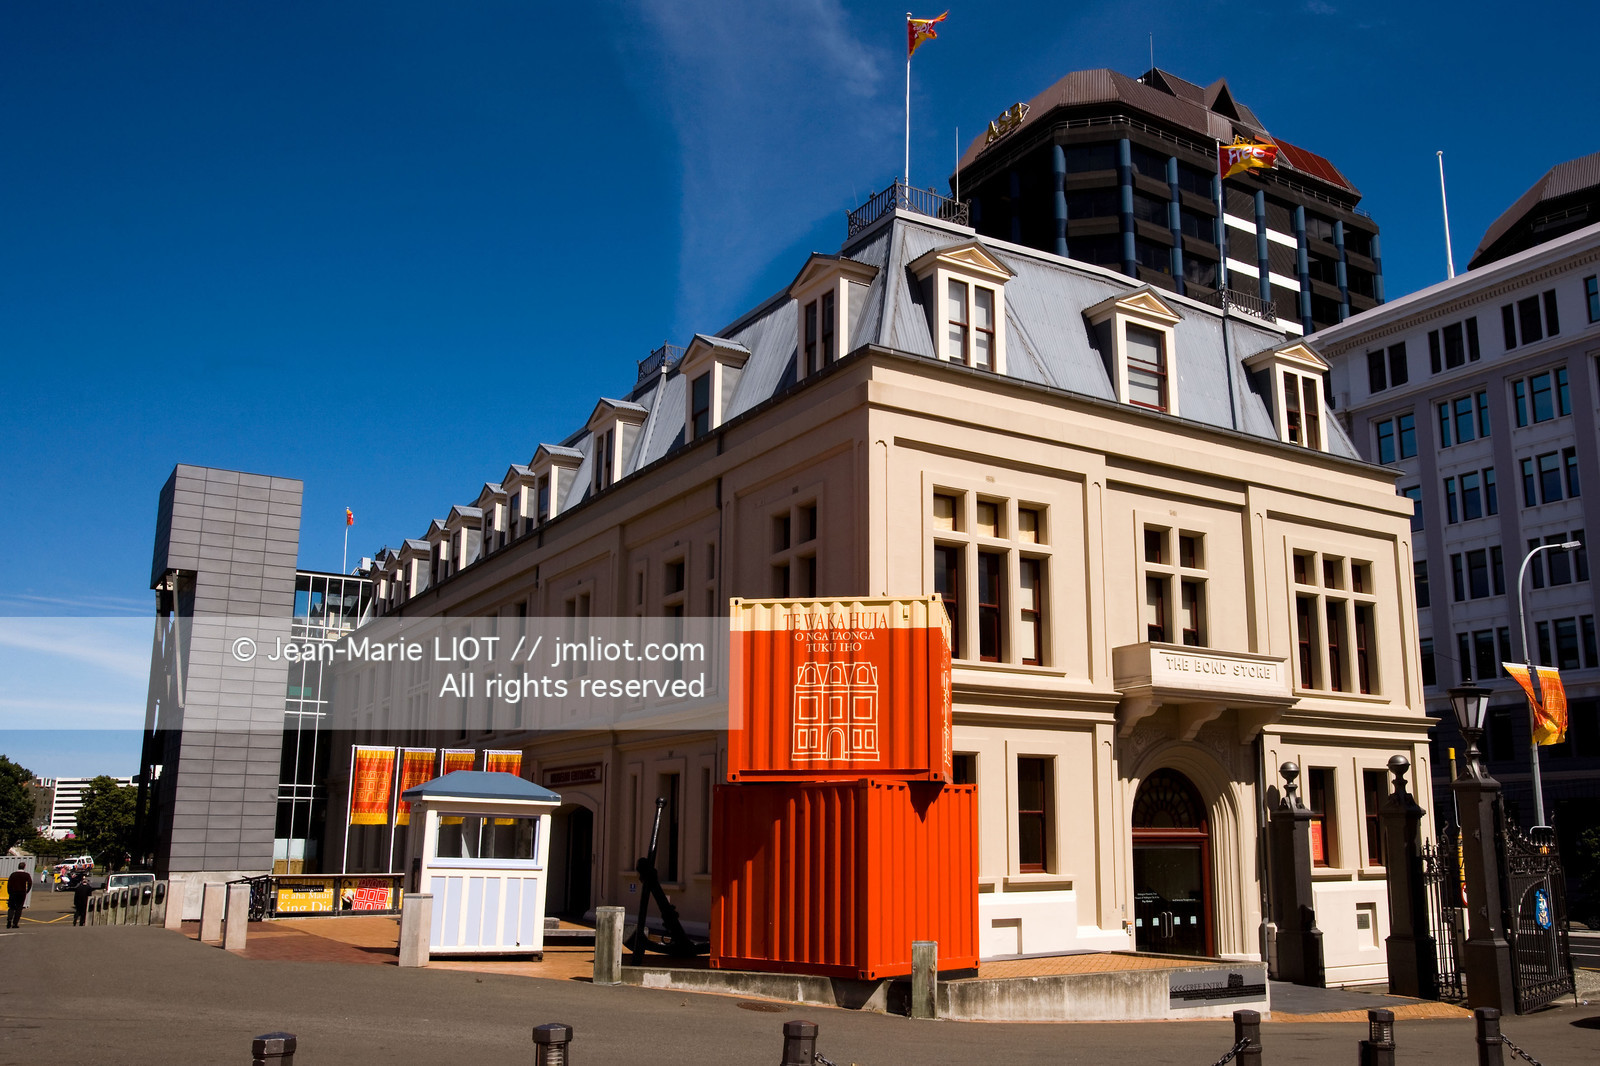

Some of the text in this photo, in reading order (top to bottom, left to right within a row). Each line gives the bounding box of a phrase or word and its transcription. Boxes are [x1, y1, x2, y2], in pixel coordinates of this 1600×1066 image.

[1228, 146, 1265, 165] Free
[783, 612, 888, 630] TE WAKA HUIA
[795, 631, 875, 641] O NGA TAONGA
[806, 642, 862, 652] TUKU IHO
[1166, 657, 1271, 679] THE BOND STORE
[1203, 981, 1224, 990] ENTRY
